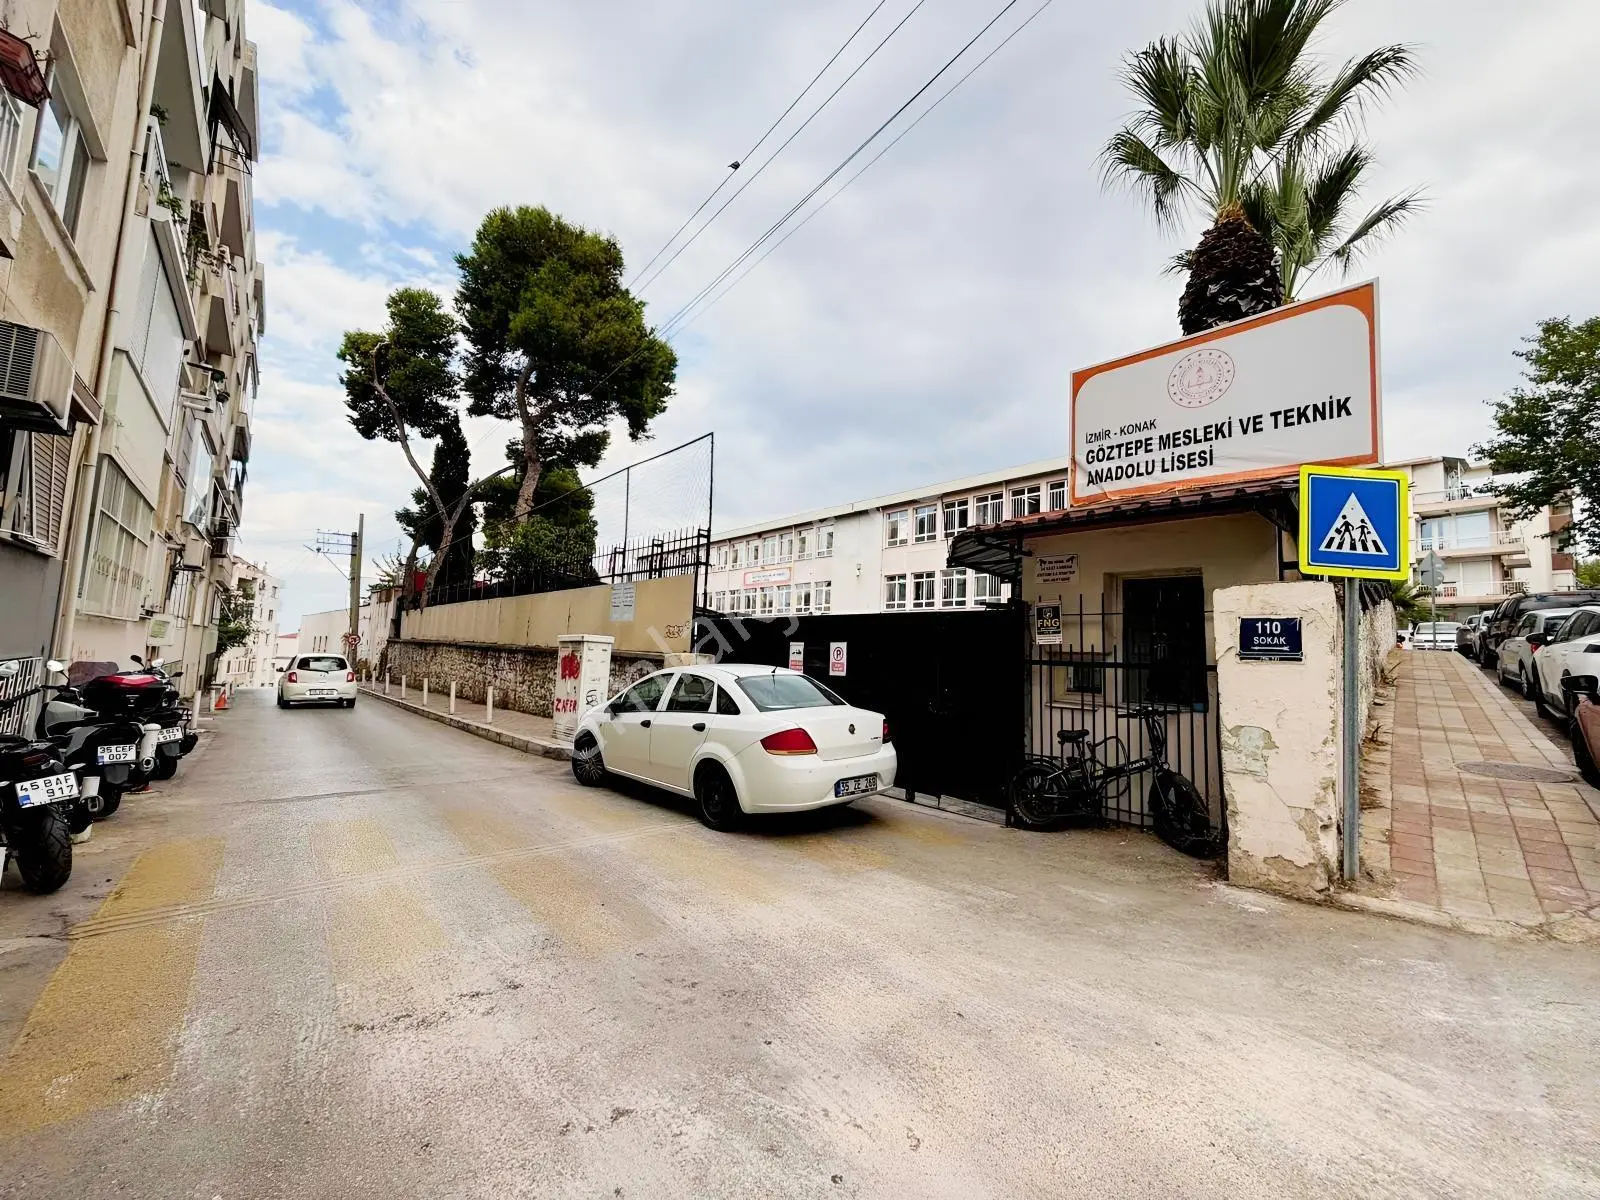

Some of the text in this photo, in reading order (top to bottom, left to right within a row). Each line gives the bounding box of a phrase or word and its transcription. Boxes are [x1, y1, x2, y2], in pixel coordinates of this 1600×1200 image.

[1085, 395, 1353, 465] GÖZTEPE MESLEKİ VE TEKNİK
[1085, 428, 1112, 444] İZMİR
[1119, 418, 1157, 437] KONAK
[1086, 444, 1214, 487] ANADOLU LİSESİ
[1037, 618, 1060, 628] FNG
[1256, 621, 1281, 634] 110
[1253, 636, 1287, 645] SOKAK
[99, 745, 134, 754] 35 CEF
[108, 753, 128, 761] 007
[20, 774, 71, 792] 45 BAF
[841, 781, 850, 792] 35
[46, 784, 73, 798] 917
